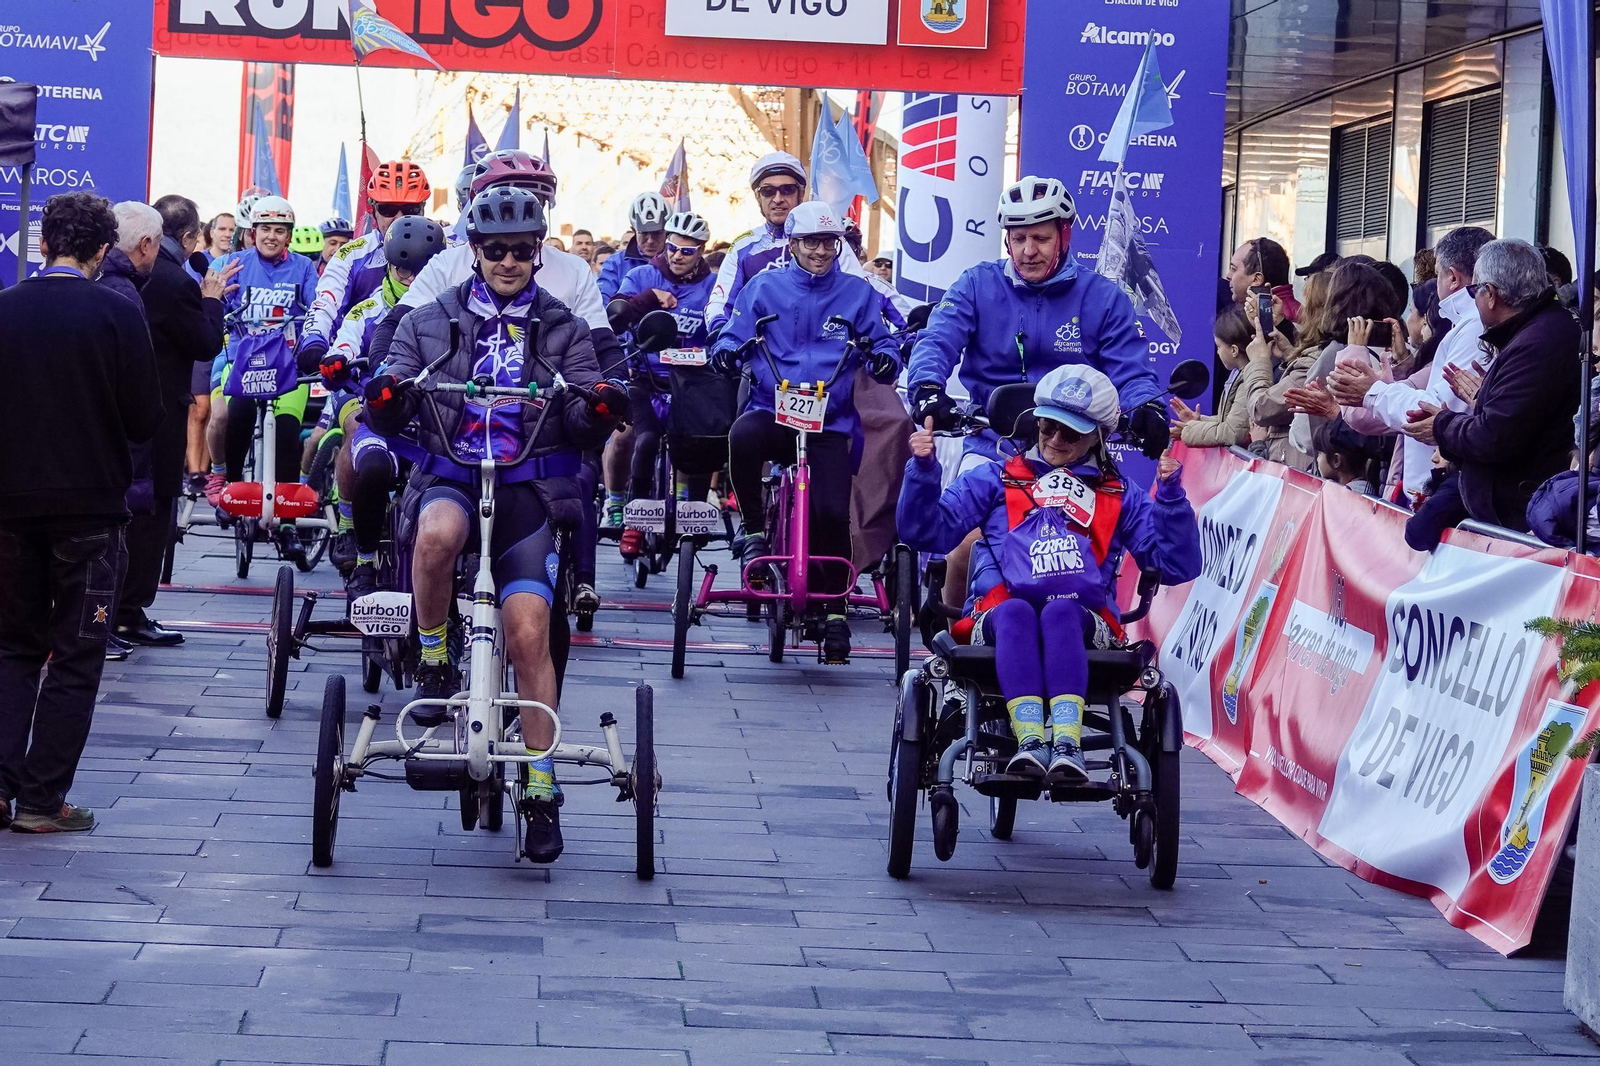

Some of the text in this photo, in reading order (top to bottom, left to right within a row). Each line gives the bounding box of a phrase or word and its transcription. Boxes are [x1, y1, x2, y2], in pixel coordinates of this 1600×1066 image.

[626, 42, 819, 80] Cáncer Vigo
[900, 56, 933, 80] La
[1069, 73, 1097, 82] GRUPO
[1065, 81, 1127, 97] BOTAM
[40, 142, 86, 151] UROS
[1077, 188, 1161, 198] SEGROS
[671, 352, 696, 360] 230
[241, 368, 278, 384] CORRER
[789, 397, 815, 415] 227
[785, 416, 813, 429] Alcampo
[1048, 474, 1086, 499] 383
[625, 506, 665, 517] turbo10
[677, 508, 718, 519] turbo10
[683, 525, 709, 533] VIGO
[1028, 534, 1080, 557] CORRER
[1030, 550, 1085, 576] XUNTOS
[353, 604, 409, 617] turbo10
[366, 623, 402, 633] VIGO
[1388, 596, 1526, 718] CONCELLO
[1357, 706, 1476, 816] DE VIGO
